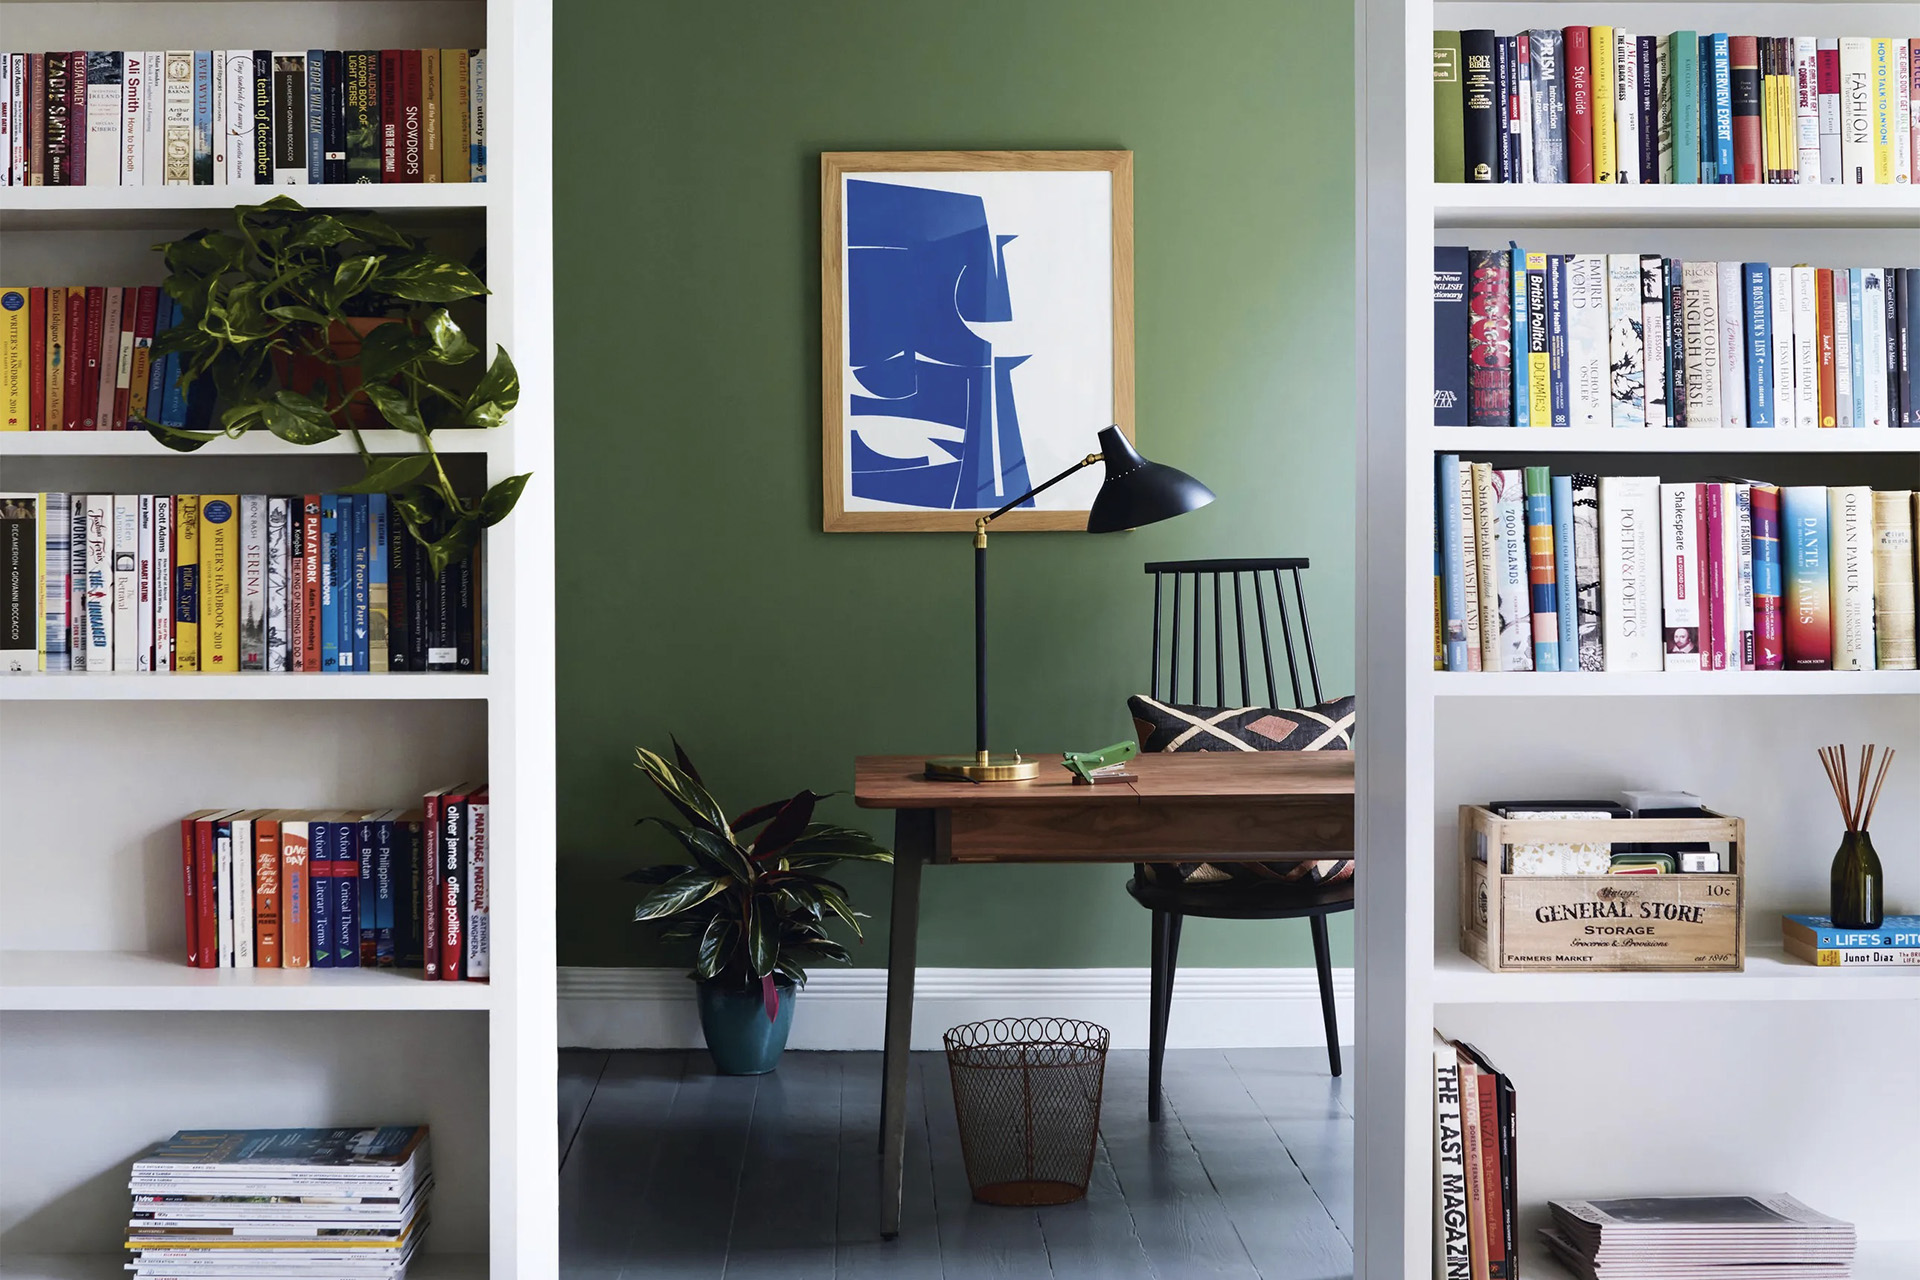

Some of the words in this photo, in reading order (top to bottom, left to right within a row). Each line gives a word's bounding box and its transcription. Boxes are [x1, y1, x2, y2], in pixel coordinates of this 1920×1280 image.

[1540, 39, 1554, 80] PRISM
[1715, 39, 1726, 56] THE
[48, 60, 66, 102] ZADIE
[74, 55, 84, 78] TESSA
[128, 59, 140, 74] Ali
[310, 60, 321, 91] PEOPLE
[348, 55, 357, 78] LIGHT
[358, 55, 367, 87] OXFORD
[1573, 66, 1584, 89] Style
[1618, 65, 1626, 82] BLACK
[1878, 65, 1886, 76] TO
[74, 80, 84, 106] HADLEY
[127, 78, 140, 113] Smith
[257, 78, 268, 106] tenth
[349, 81, 357, 106] VERSE
[368, 71, 377, 106] AUDEN'S
[1618, 83, 1626, 100] DRESS
[1716, 59, 1729, 106] INTERVIEW
[1879, 78, 1887, 97] TALK
[255, 108, 269, 121] of
[310, 94, 321, 113] WILL
[358, 89, 367, 112] BOOK
[1575, 91, 1585, 114] Guide
[1852, 73, 1868, 143] FASHION
[1879, 99, 1887, 110] TO
[48, 106, 66, 154] SMITH
[127, 118, 135, 133] How
[310, 115, 321, 134] TALK
[358, 114, 368, 125] OF
[386, 124, 394, 137] EVER
[476, 106, 484, 136] utterly
[1718, 109, 1730, 141] EXPERT
[1880, 112, 1888, 145] ANYONE
[127, 143, 135, 153] be
[258, 123, 270, 175] december
[386, 138, 394, 146] THE
[406, 106, 418, 174] SNOWDROPS
[127, 155, 135, 172] both
[386, 148, 395, 172] DIPLOMAT
[476, 139, 484, 172] monkey
[1531, 275, 1543, 310] British
[1572, 260, 1586, 309] WORD
[1590, 259, 1600, 309] EMPIRES
[1753, 272, 1762, 283] MR
[52, 289, 61, 312] Kazuo
[1702, 289, 1710, 306] THE
[51, 313, 60, 342] Ishiguro
[1532, 313, 1545, 351] Politics
[1686, 289, 1701, 357] ENGLISH
[1704, 307, 1715, 367] OXFORD
[1754, 340, 1765, 357] LIST
[10, 352, 18, 396] HANDBOOK
[1590, 359, 1599, 408] NICHOLAS
[1689, 364, 1703, 408] VERSE
[9, 399, 17, 413] 2010
[1706, 395, 1713, 406] OF
[1477, 468, 1487, 482] The
[159, 502, 167, 524] Scott
[1740, 490, 1750, 512] ICONS
[73, 515, 86, 546] WORK
[308, 518, 317, 540] PLAY
[1479, 485, 1491, 560] SHAKESPEARE
[1505, 509, 1516, 536] 7000
[1674, 491, 1686, 550] Shakespeare
[1740, 514, 1750, 523] OF
[1845, 493, 1856, 542] ORHAN
[215, 528, 223, 572] WRITER'S
[308, 543, 316, 554] AT
[1741, 525, 1751, 556] FASHION
[1805, 518, 1818, 567] DANTE
[73, 549, 86, 575] WITH
[247, 545, 259, 596] SERENA
[307, 556, 316, 583] WORK
[1507, 539, 1518, 584] ISLANDS
[1847, 547, 1858, 593] PAMUK
[74, 578, 85, 592] ME
[89, 570, 103, 588] THE
[215, 574, 223, 629] HANDBOOK
[294, 592, 301, 600] OF
[1798, 579, 1813, 624] JAMES
[88, 601, 107, 647] UNNAMED
[307, 616, 315, 651] Penenberg
[214, 631, 222, 649] 2010
[294, 636, 301, 645] TO
[294, 646, 301, 657] DO
[447, 806, 458, 836] oliver
[315, 826, 325, 858] Oxford
[339, 827, 351, 859] Oxford
[474, 813, 485, 862] MARRIAGE
[362, 848, 371, 879] Bhutan
[445, 837, 459, 870] james
[379, 847, 390, 899] Philippines
[315, 881, 327, 915] Literary
[341, 882, 352, 912] Critical
[448, 876, 460, 906] office
[474, 866, 486, 911] MATERIAL
[446, 907, 459, 945] politics
[1536, 901, 1634, 924] GENERAL
[1640, 902, 1706, 924] STORE
[317, 919, 327, 946] Terms
[340, 915, 352, 946] Theory
[471, 915, 479, 955] SANGHERA
[1570, 938, 1609, 947] Groceries
[1611, 938, 1619, 947] &
[1621, 938, 1670, 947] Provisions
[1584, 926, 1655, 935] STORAGE
[1836, 935, 1880, 945] LIFE'S
[1884, 937, 1892, 945] a
[1895, 934, 1920, 945] PIT
[1844, 953, 1869, 963] Junot
[1438, 1065, 1458, 1103] THE
[1440, 1114, 1461, 1164] LAST
[1444, 1174, 1469, 1280] MAGAZIN
